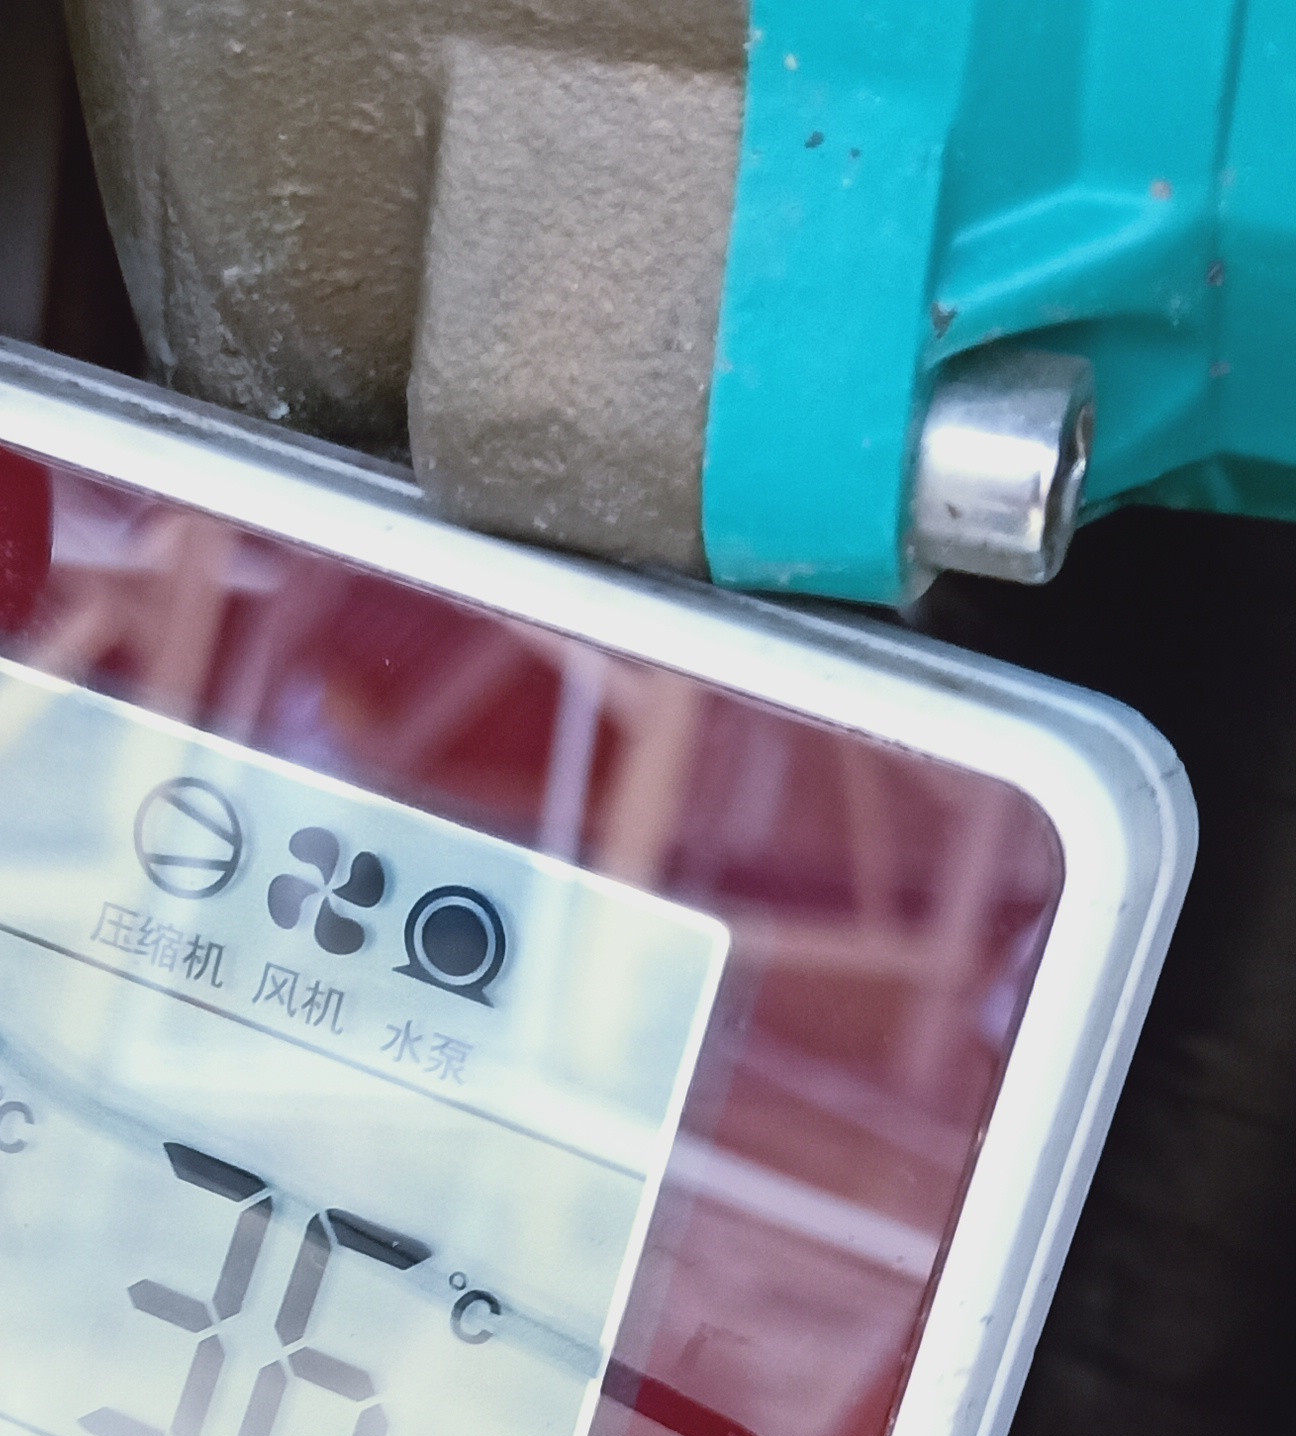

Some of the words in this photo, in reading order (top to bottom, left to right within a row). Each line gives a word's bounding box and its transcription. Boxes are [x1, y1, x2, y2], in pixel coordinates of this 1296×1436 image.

[90, 901, 225, 990] 压缩机
[251, 961, 346, 1036] 风机
[380, 1019, 475, 1087] 水泵
